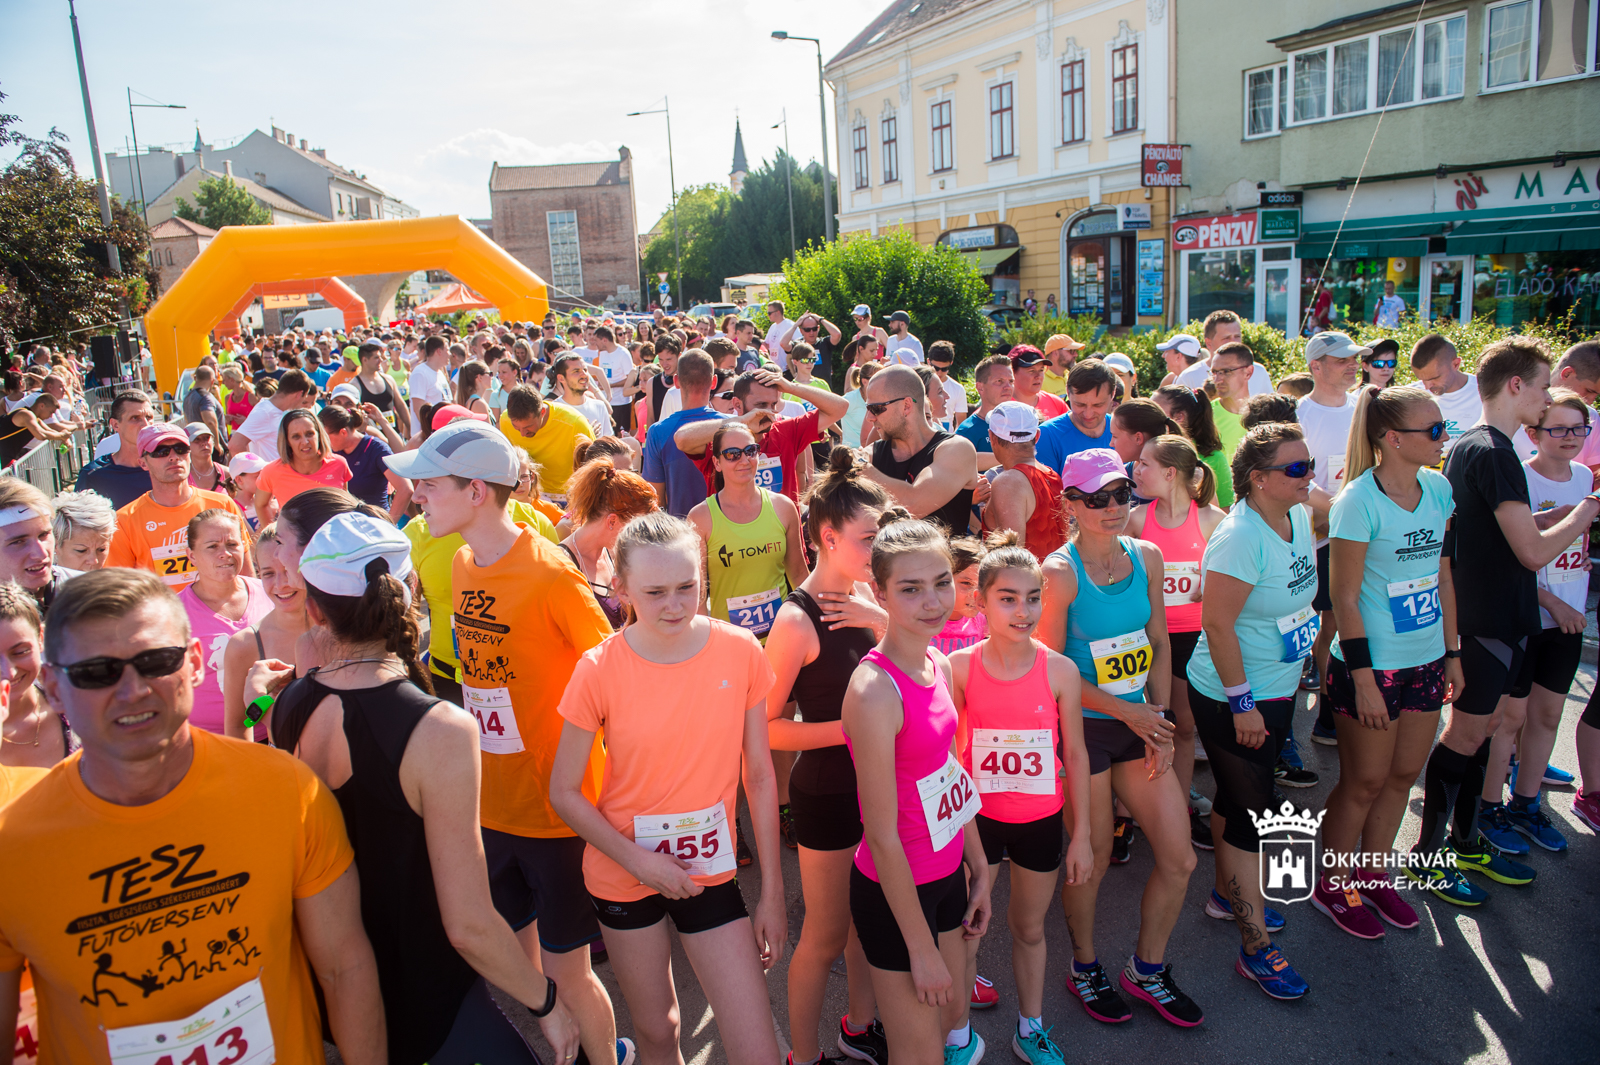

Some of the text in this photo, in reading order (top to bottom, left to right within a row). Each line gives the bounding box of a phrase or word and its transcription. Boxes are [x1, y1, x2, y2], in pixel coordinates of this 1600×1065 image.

[1144, 145, 1182, 160] PÉNZVÁLTÓ
[1144, 173, 1182, 186] CHANGE
[1514, 166, 1600, 200] MA
[1268, 192, 1295, 203] adidas
[1494, 272, 1560, 299] ELADÓ,
[739, 542, 782, 559] TOMFIT
[1403, 528, 1437, 547] TESZ
[163, 556, 195, 575] 27
[1289, 555, 1312, 579] TESZ
[1555, 551, 1582, 570] 42
[1163, 577, 1192, 594] 30
[460, 590, 496, 621] TESZ
[738, 602, 775, 626] 211
[1402, 588, 1439, 617] 120
[1292, 621, 1318, 652] 136
[1105, 649, 1148, 680] 302
[980, 751, 1043, 776] 403
[937, 772, 973, 822] 402
[654, 829, 719, 860] 455
[88, 844, 217, 904] TESZ
[108, 899, 158, 922] EGÉSZSÉGES
[159, 877, 240, 908] SZÉKESFEHÉRVÁRÉRT
[77, 893, 240, 958] FUTÓVERSENY
[154, 1026, 249, 1065] 13
